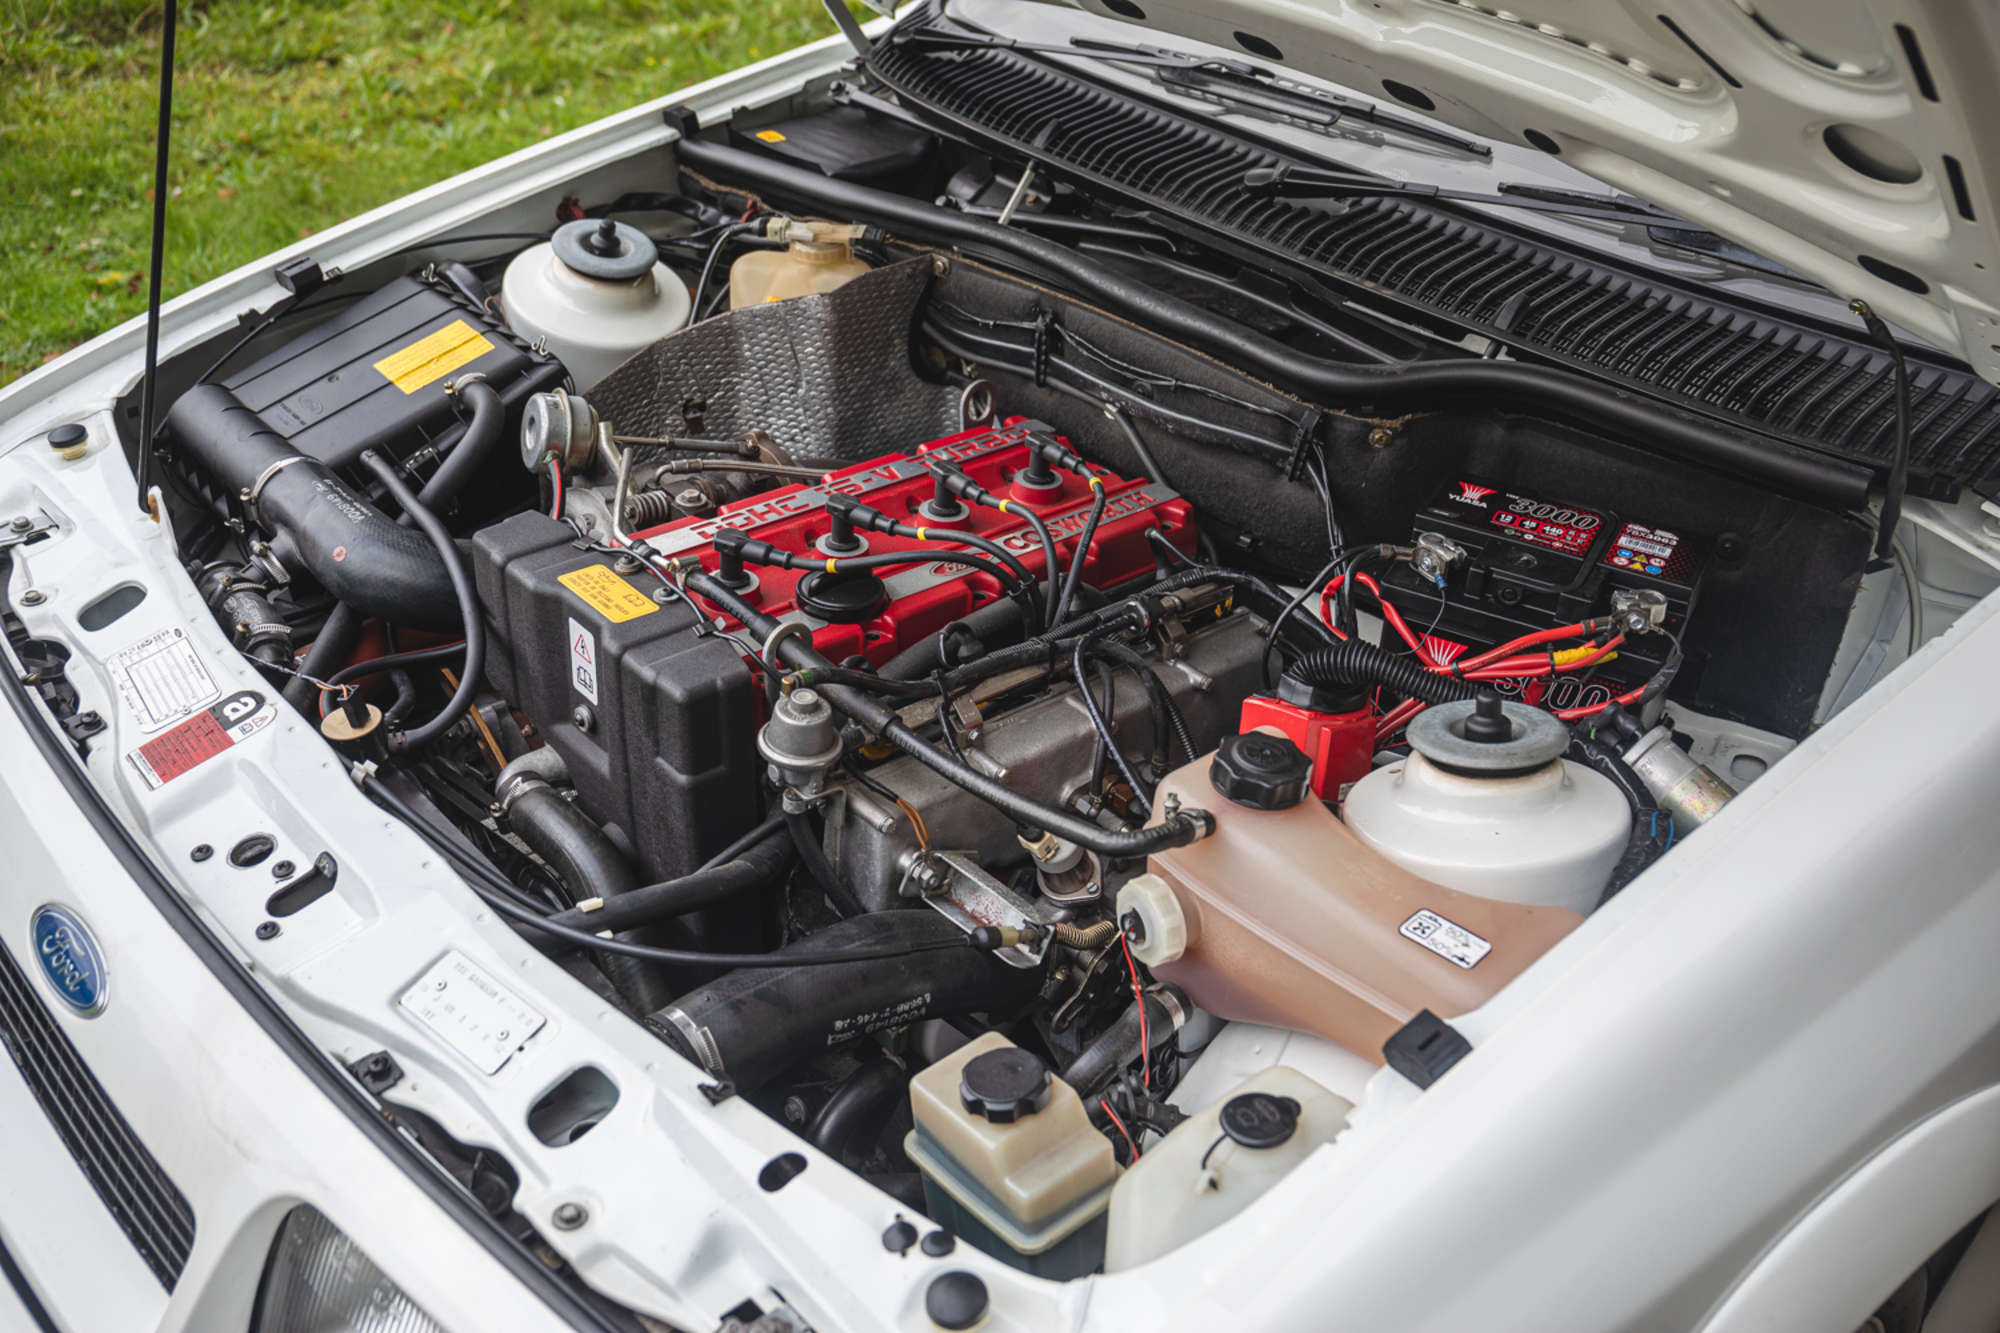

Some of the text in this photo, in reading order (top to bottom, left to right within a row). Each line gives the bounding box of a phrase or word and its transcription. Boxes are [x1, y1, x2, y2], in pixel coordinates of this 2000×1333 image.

[905, 427, 1031, 470] TURBO
[1448, 493, 1488, 508] YUASA
[1508, 498, 1600, 530] 3000
[41, 926, 91, 993] Ford
